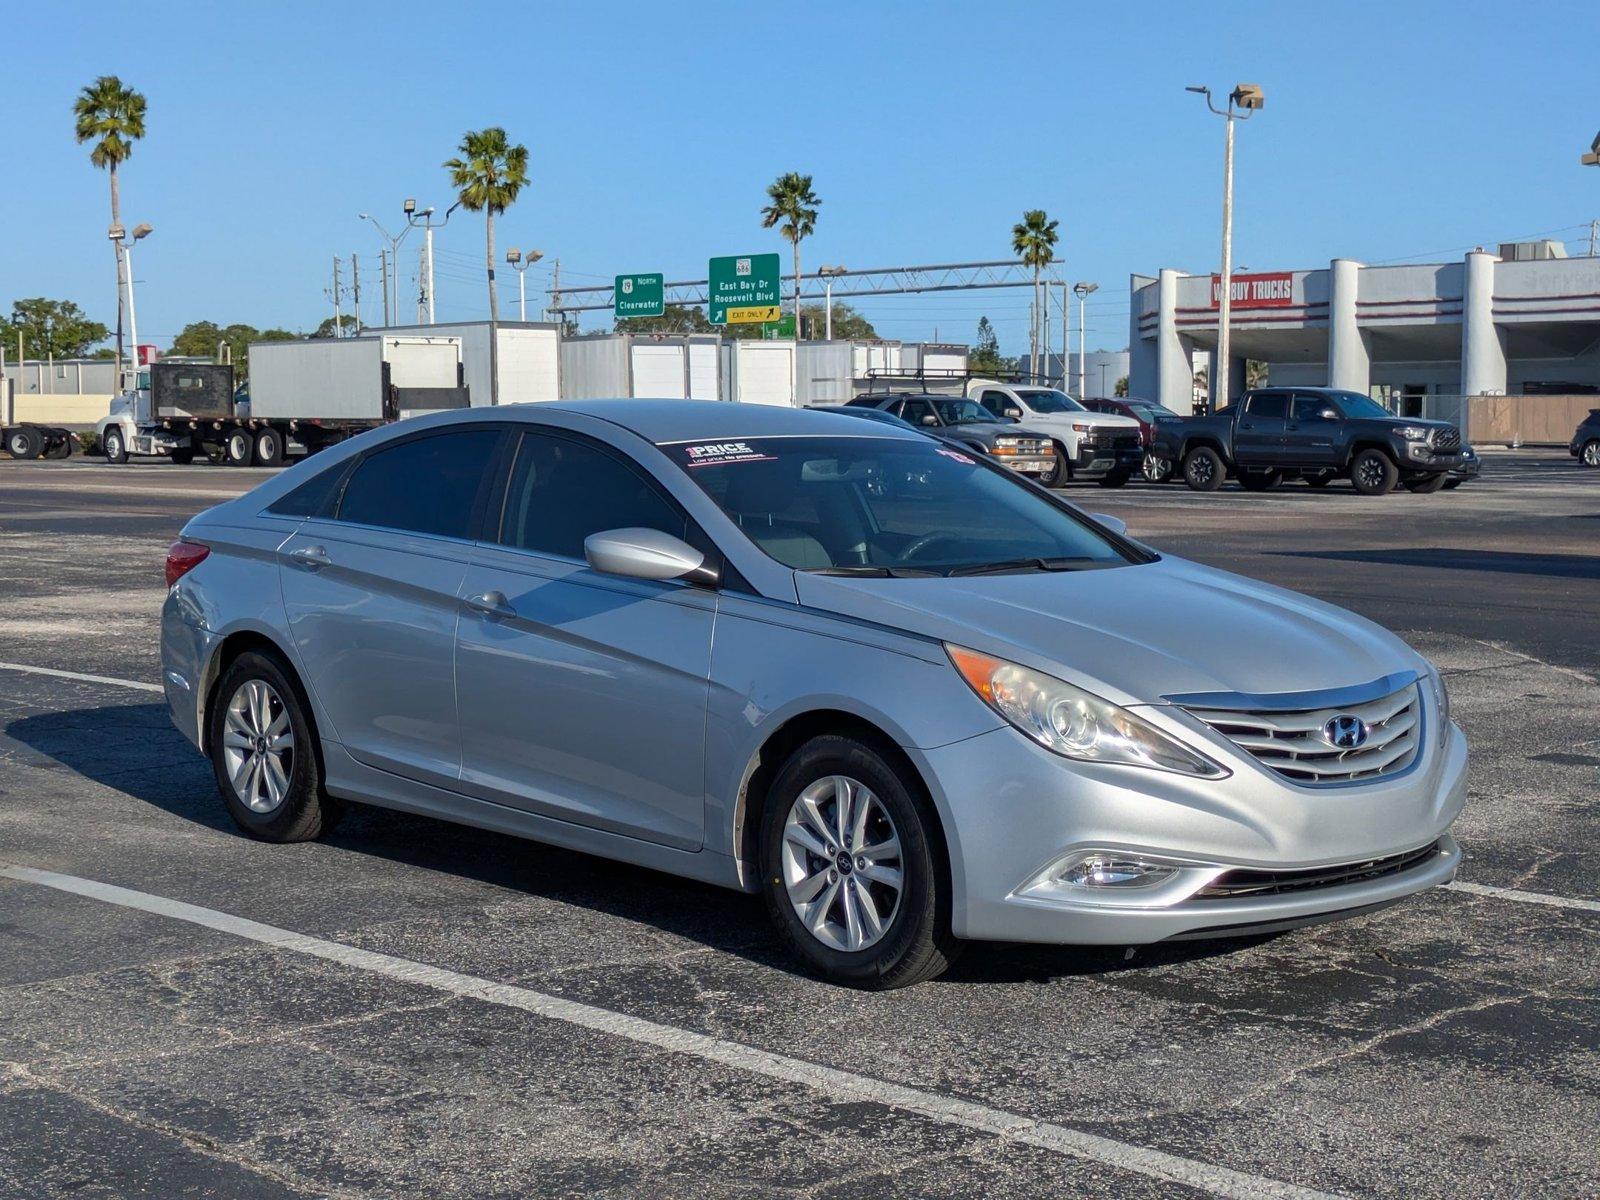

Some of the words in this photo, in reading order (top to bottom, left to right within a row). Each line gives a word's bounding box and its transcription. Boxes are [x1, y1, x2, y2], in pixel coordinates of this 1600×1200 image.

[638, 277, 657, 285] NORTH
[719, 281, 737, 290] East
[740, 280, 755, 290] Bay
[758, 279, 769, 288] Dr
[1230, 281, 1249, 301] BUY
[1252, 280, 1291, 300] TRUCKS
[714, 293, 753, 303] Roosevelt
[756, 291, 774, 301] Blvd
[619, 301, 659, 310] Clearwater
[747, 310, 764, 318] ONLY
